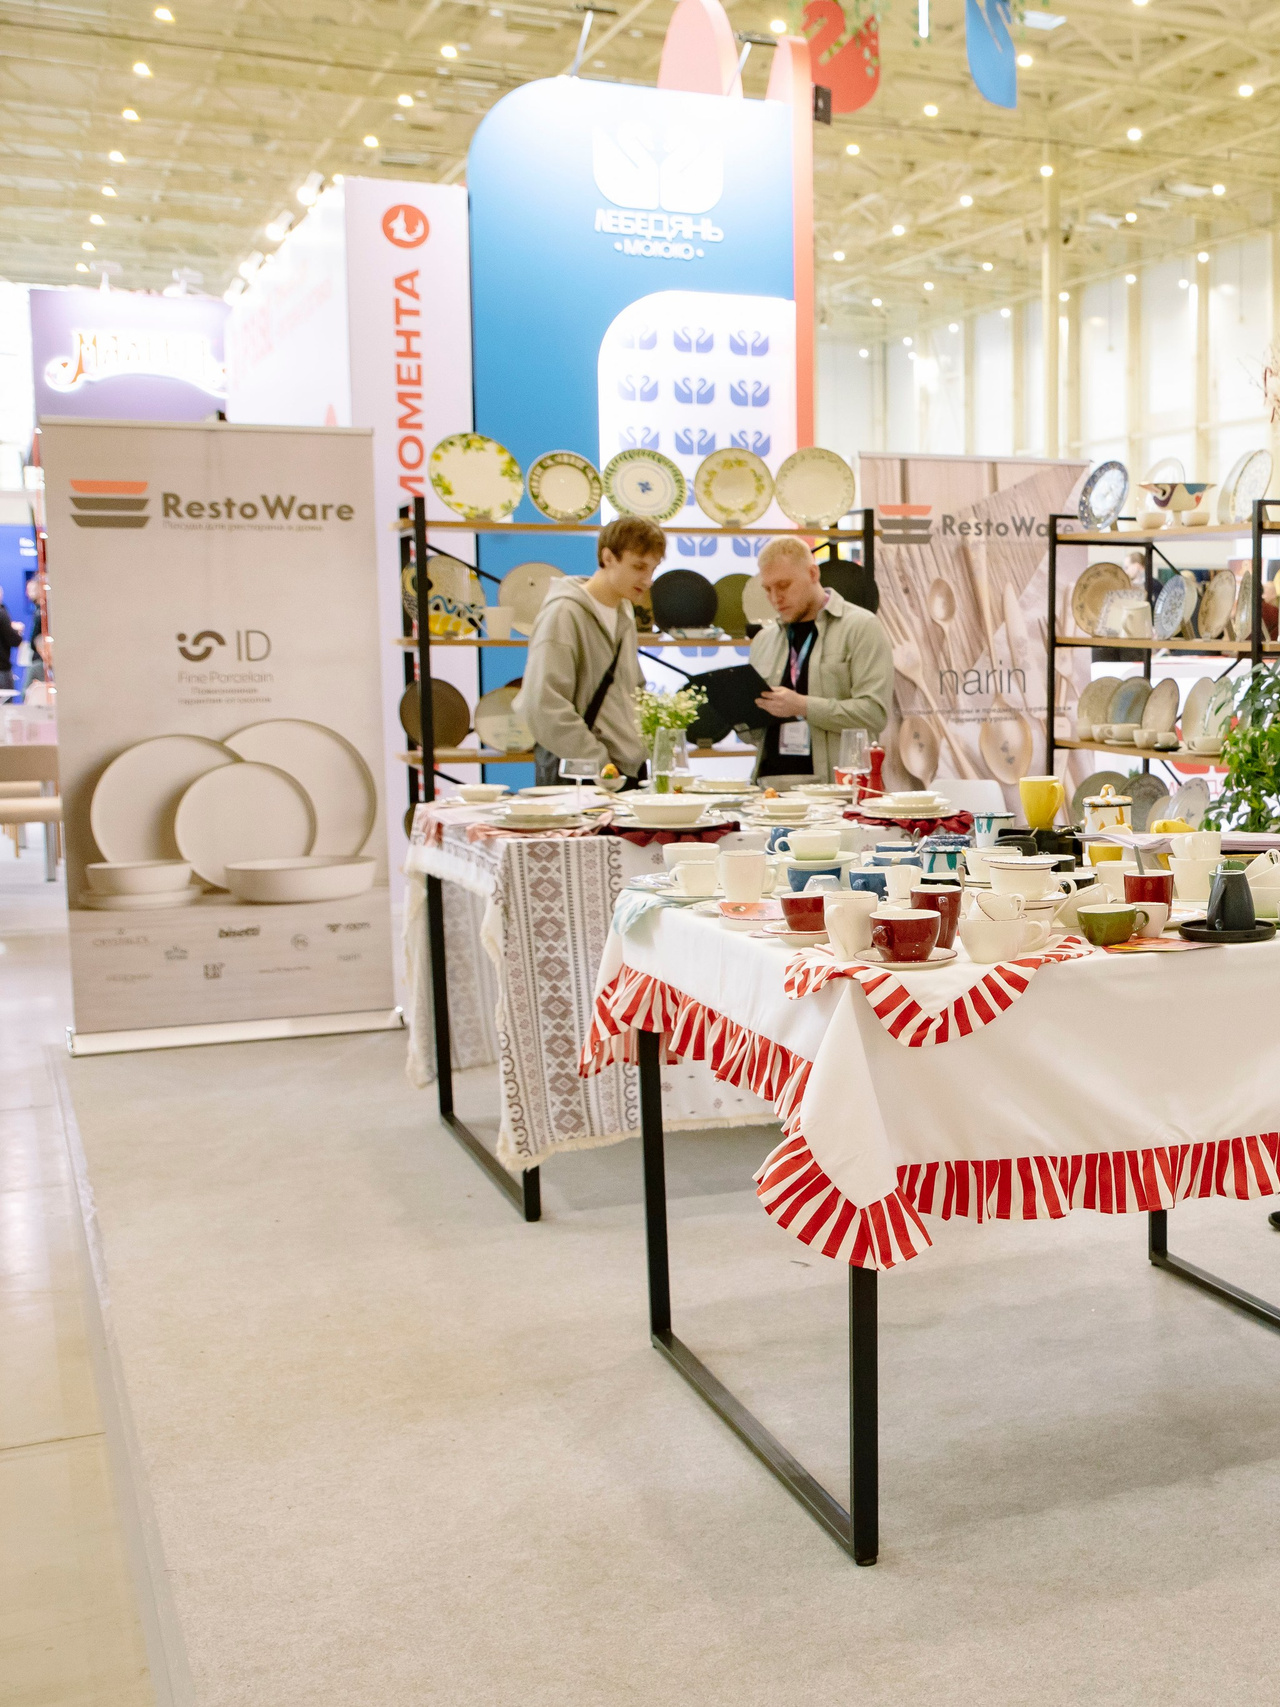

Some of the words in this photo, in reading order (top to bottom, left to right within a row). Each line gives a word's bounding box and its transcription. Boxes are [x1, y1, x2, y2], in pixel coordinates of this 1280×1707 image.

[162, 492, 355, 521] RestoWare
[941, 514, 1075, 537] RestoWae
[236, 630, 271, 662] ID
[938, 660, 1026, 695] narin
